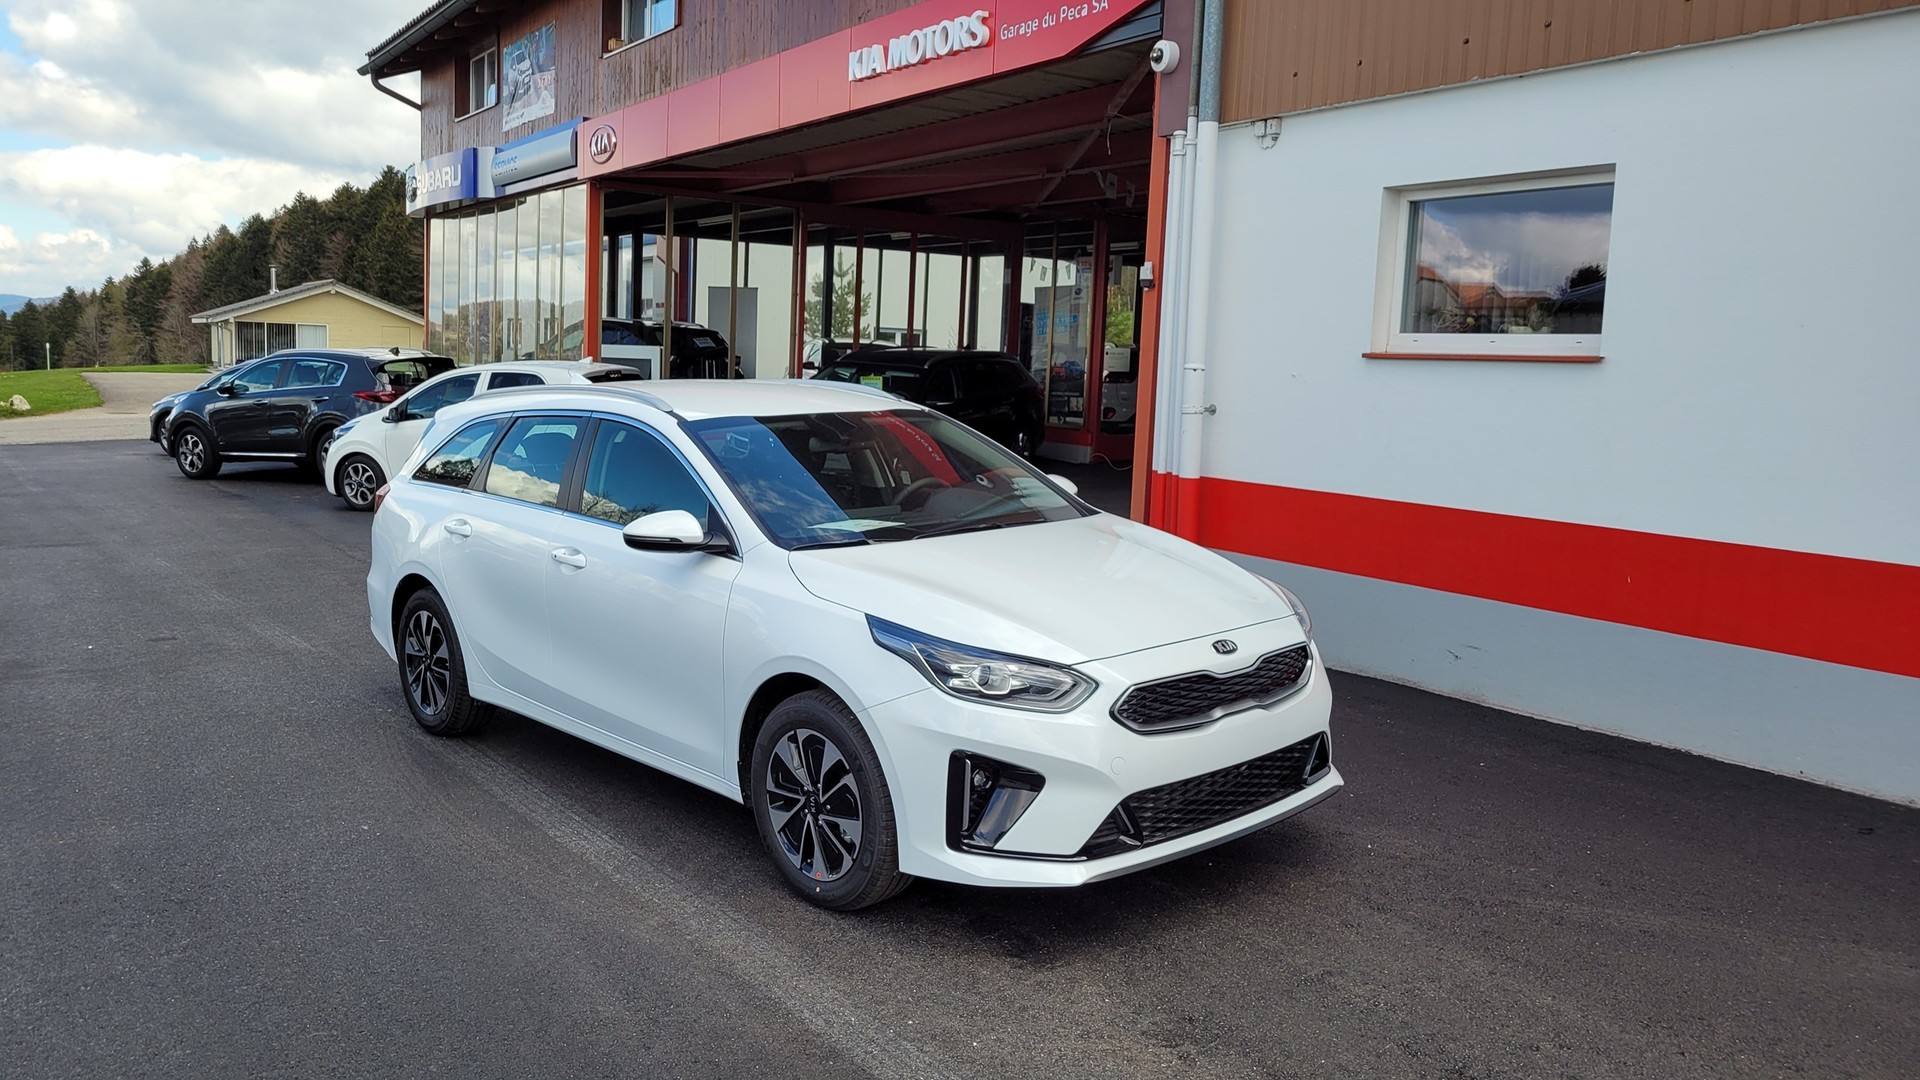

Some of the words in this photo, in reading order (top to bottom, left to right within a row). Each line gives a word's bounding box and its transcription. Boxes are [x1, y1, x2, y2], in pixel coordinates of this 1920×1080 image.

[1000, 18, 1039, 40] Garage
[1042, 11, 1057, 28] du
[1060, 3, 1088, 22] Peca
[1092, 0, 1109, 14] SA
[848, 44, 887, 81] KIA
[887, 10, 990, 70] MOTORS
[591, 131, 613, 157] KIA
[416, 163, 462, 196] SUBARU
[1213, 640, 1237, 653] KIA
[809, 796, 817, 813] KIA
